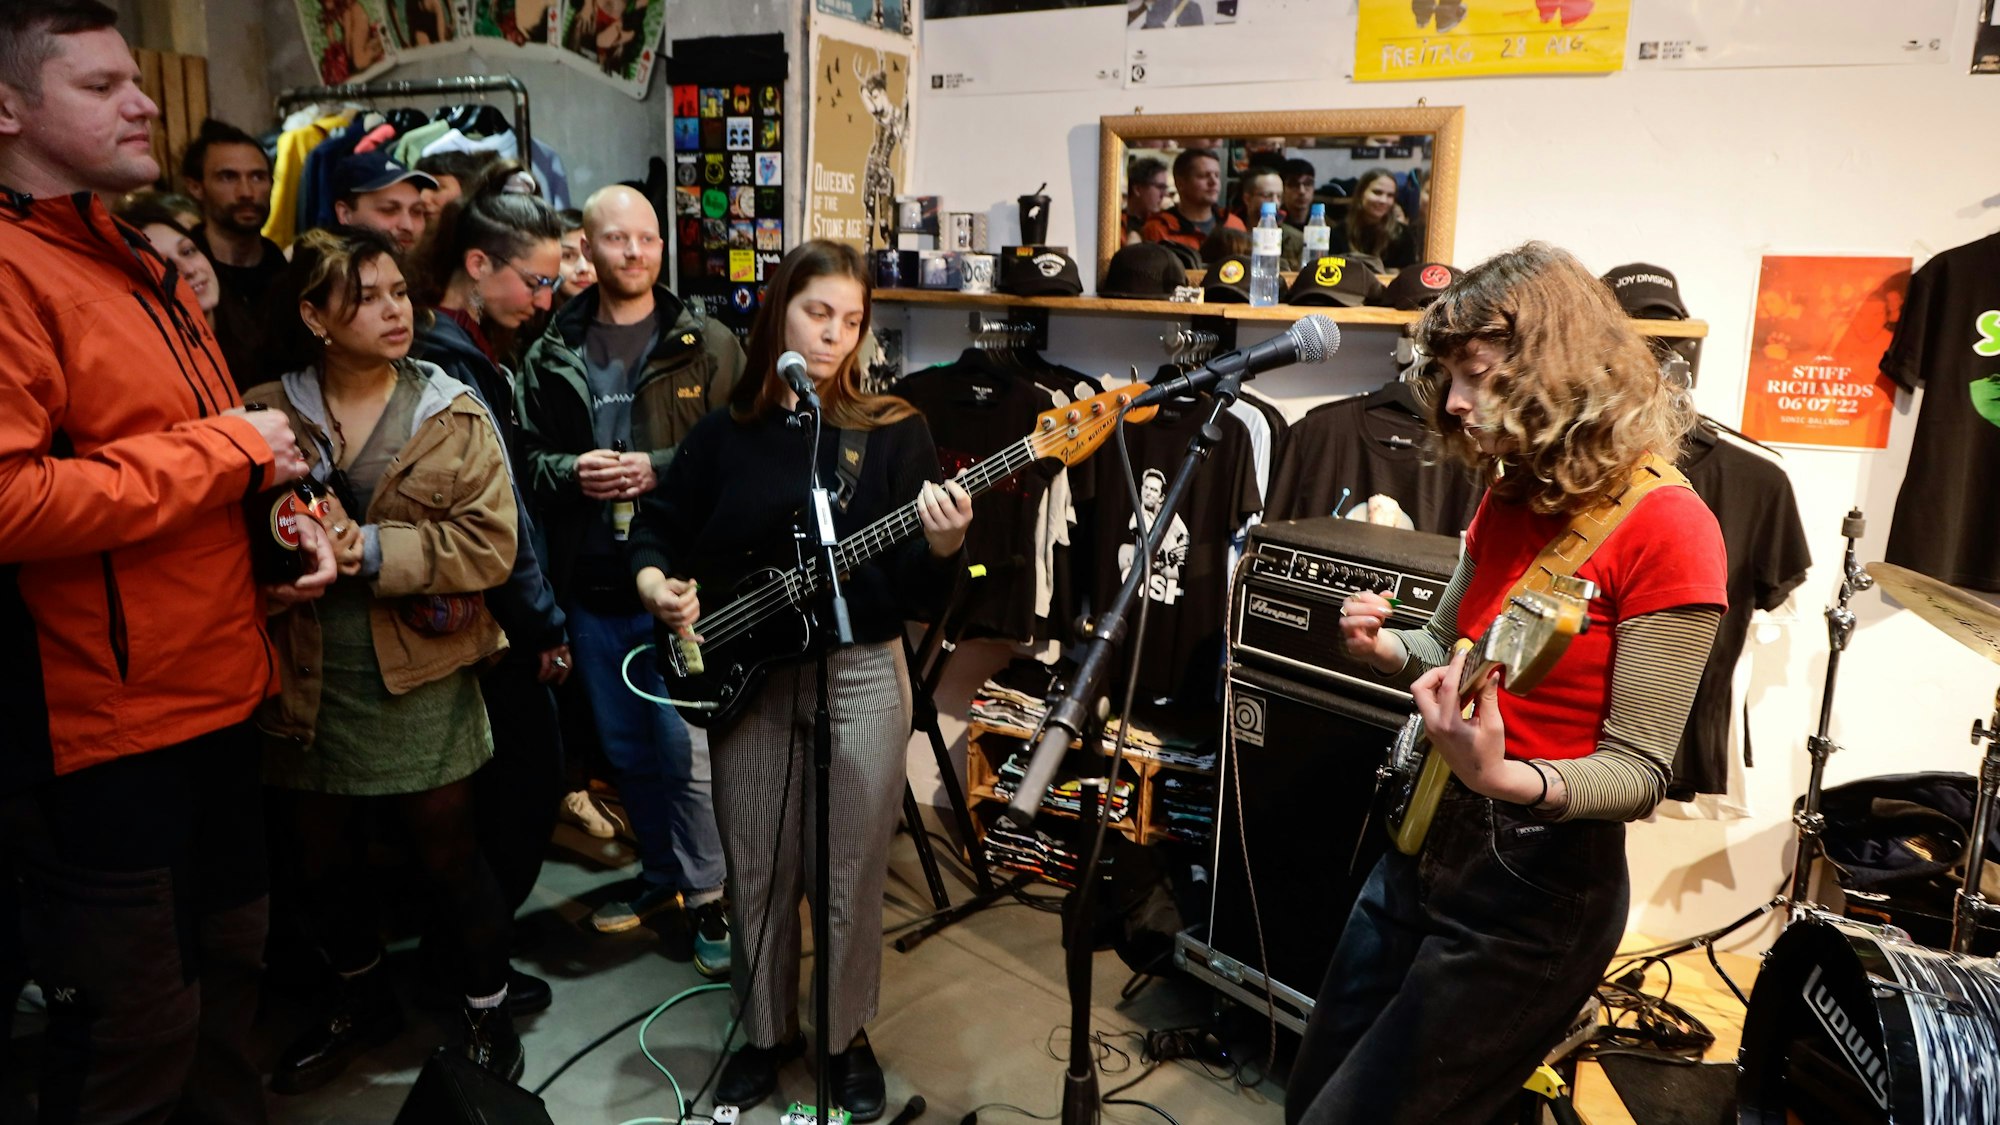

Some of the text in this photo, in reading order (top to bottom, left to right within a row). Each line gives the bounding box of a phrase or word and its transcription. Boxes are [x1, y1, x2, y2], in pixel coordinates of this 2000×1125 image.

[1382, 39, 1475, 73] FREITAG
[1501, 38, 1527, 59] 28
[814, 161, 856, 195] QUEENS
[813, 212, 863, 239] STONE AGE
[1615, 273, 1673, 289] JOY DIVISION
[1792, 364, 1852, 381] STIFF
[1766, 380, 1874, 398] RICHARDS
[1061, 440, 1086, 463] Fender
[1251, 599, 1307, 626] Ampeg
